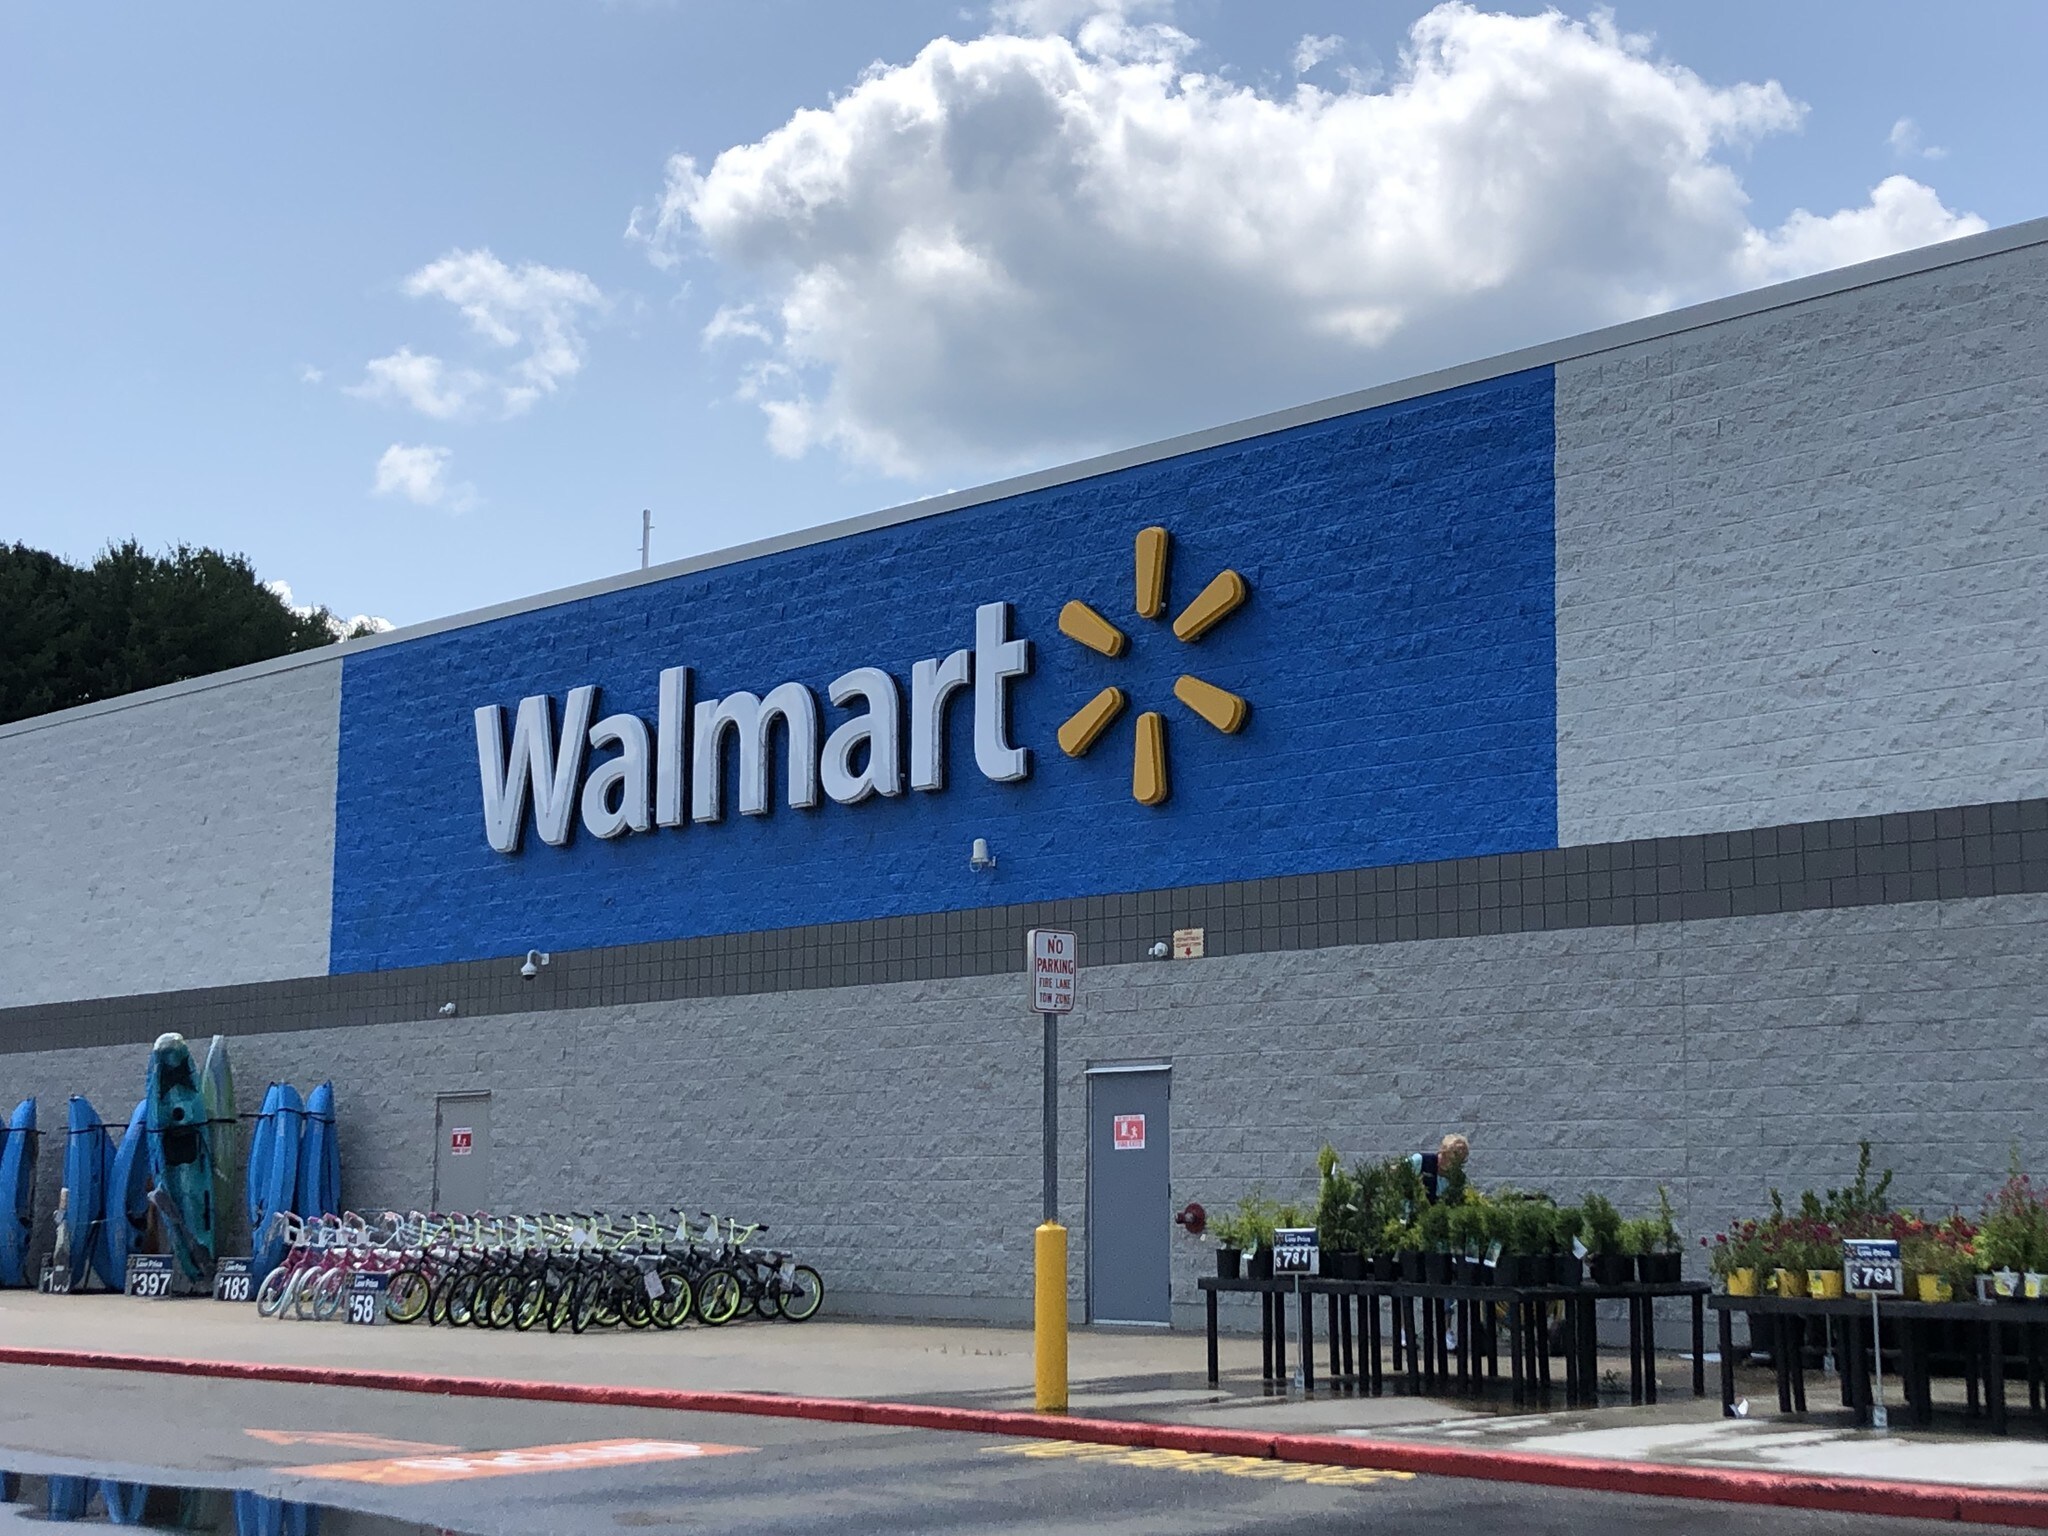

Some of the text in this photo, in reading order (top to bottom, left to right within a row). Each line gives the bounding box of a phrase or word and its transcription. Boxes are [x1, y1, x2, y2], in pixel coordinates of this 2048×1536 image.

[474, 601, 1029, 853] Walmart
[1047, 938, 1064, 955] NO
[1036, 957, 1074, 975] PARKING
[1039, 977, 1071, 990] FIRE LANE
[1039, 992, 1071, 1005] TOW ZONE
[132, 1273, 172, 1296] $397
[219, 1276, 250, 1300] $183
[350, 1294, 375, 1323] $58
